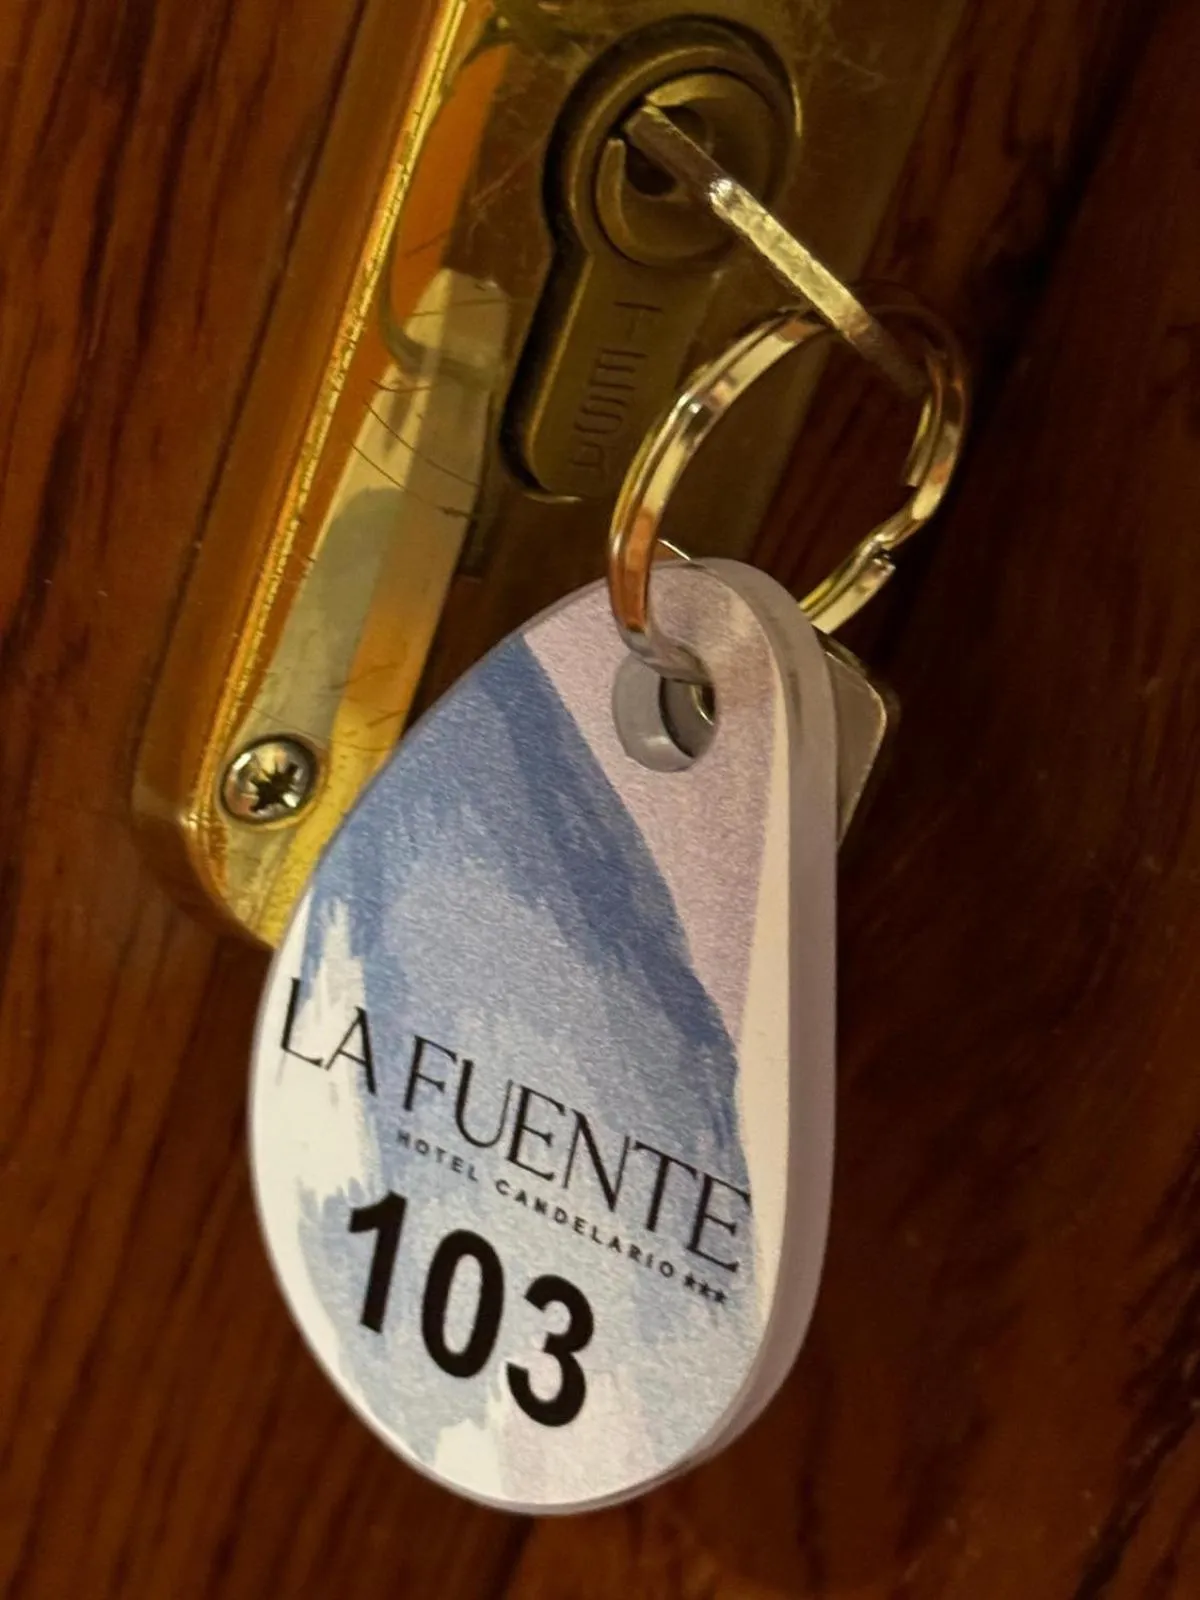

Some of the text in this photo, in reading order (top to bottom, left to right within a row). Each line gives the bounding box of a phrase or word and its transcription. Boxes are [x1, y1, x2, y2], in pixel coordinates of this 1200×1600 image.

[279, 977, 752, 1274] LA FUENTE
[396, 1129, 676, 1277] HOTEL CANDELARIO
[348, 1189, 595, 1428] 103
